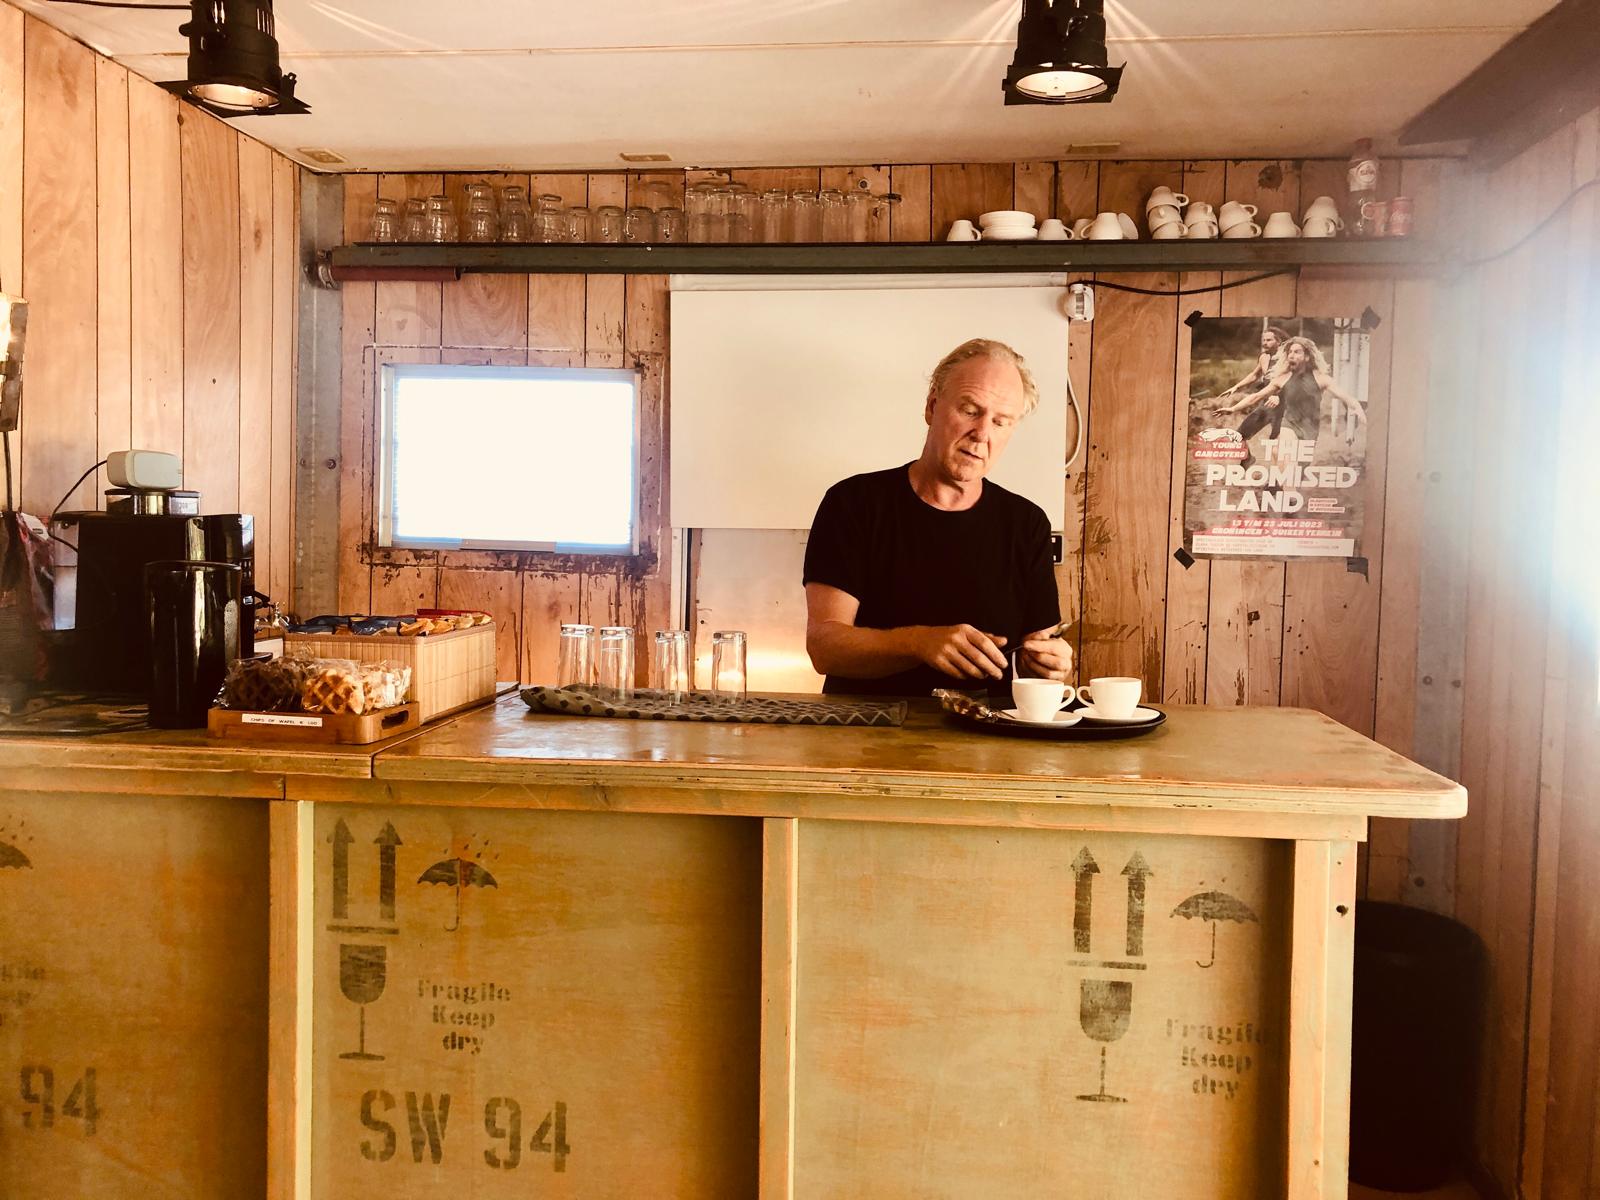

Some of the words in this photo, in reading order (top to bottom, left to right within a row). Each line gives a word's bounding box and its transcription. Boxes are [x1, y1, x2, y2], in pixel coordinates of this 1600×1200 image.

[1194, 450, 1246, 458] GANGSTERS
[1260, 439, 1316, 462] THE
[1206, 464, 1359, 488] PROMISED
[1219, 489, 1304, 513] LAND
[1277, 520, 1297, 528] JULI
[418, 979, 511, 1005] Fragile
[432, 1004, 496, 1030] Keep
[442, 1031, 484, 1056] dry
[1182, 1046, 1252, 1075] Keep
[20, 1063, 98, 1137] 94
[1192, 1074, 1239, 1101] dry
[359, 1089, 451, 1165] SW
[484, 1096, 571, 1173] 94
